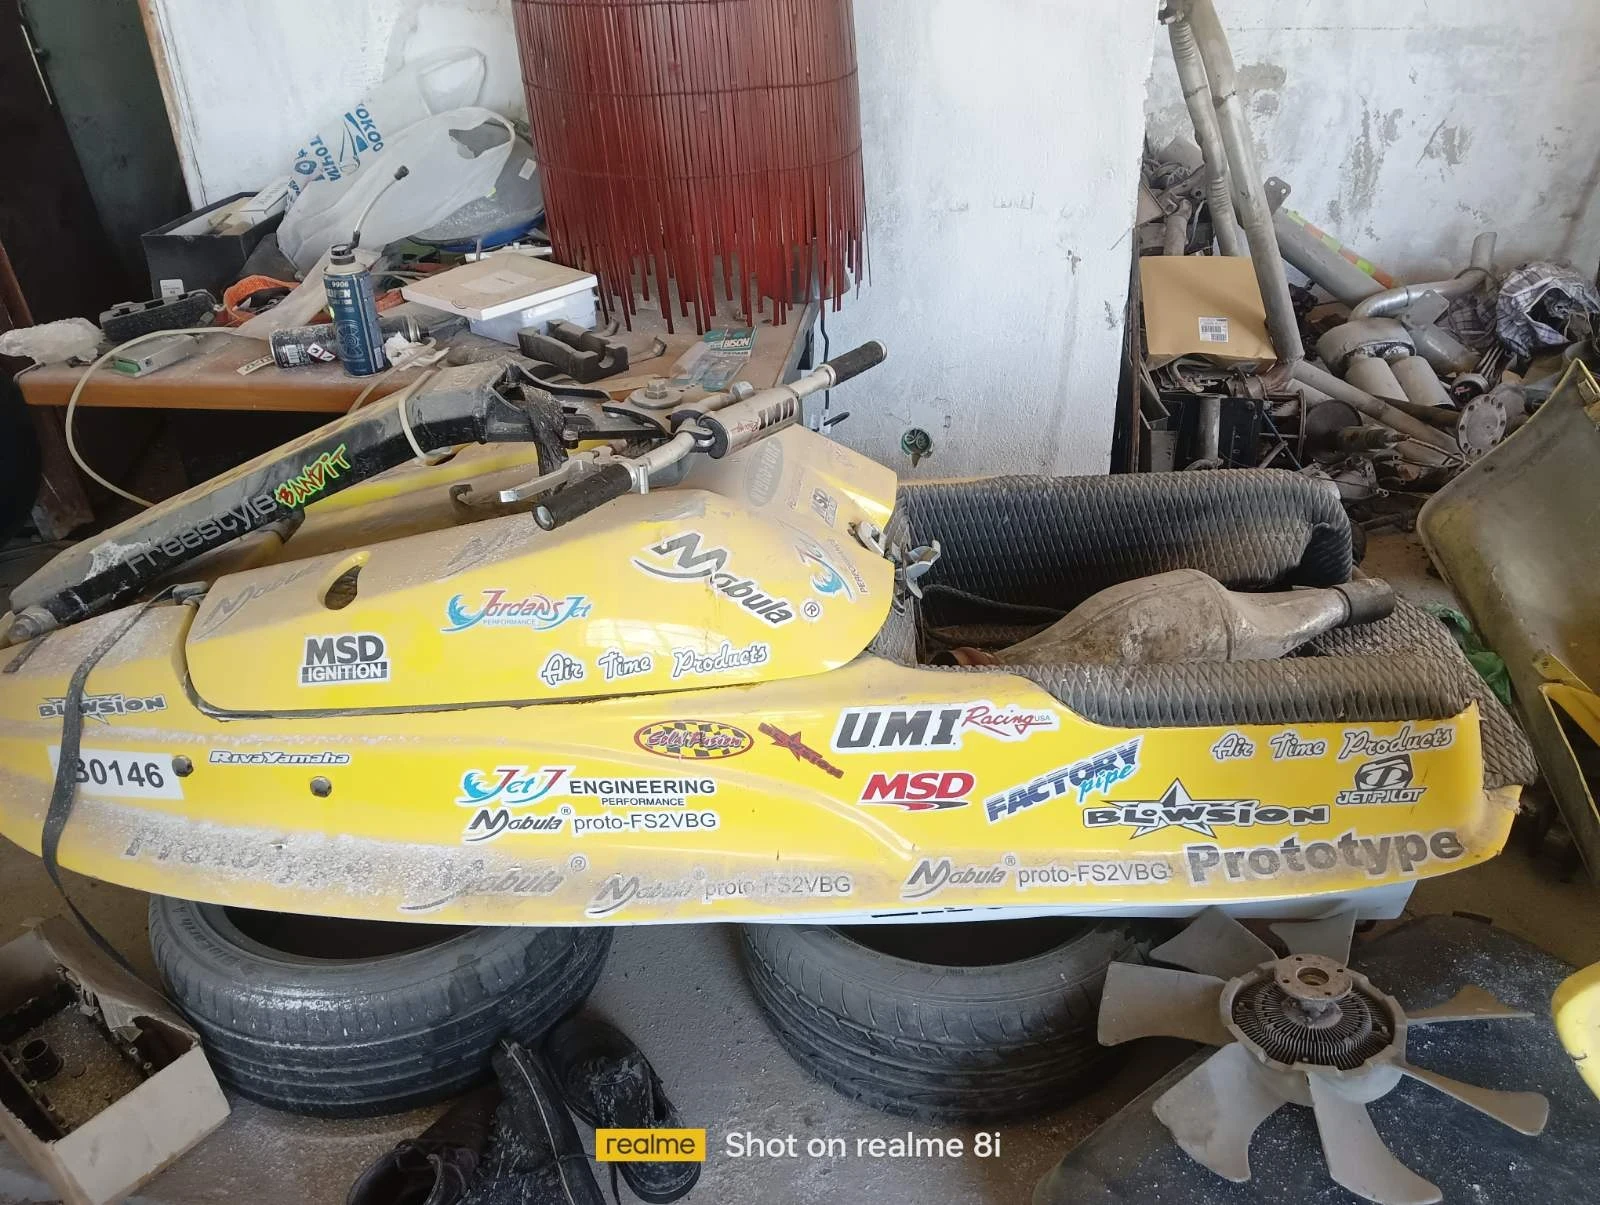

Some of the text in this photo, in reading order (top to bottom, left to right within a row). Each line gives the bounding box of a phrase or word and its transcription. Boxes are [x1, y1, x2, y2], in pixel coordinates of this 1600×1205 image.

[724, 337, 750, 348] BISON
[125, 494, 278, 576] Freestyle
[482, 618, 536, 626] PERFORMANCE
[305, 635, 384, 665] MSD
[307, 663, 383, 682] IGNITION
[541, 644, 767, 685] Air Time Products
[961, 705, 1040, 735] Racing
[1212, 726, 1452, 760] Air Time Products
[569, 780, 716, 795] ENGINEERING
[861, 772, 974, 800] MSD
[986, 738, 1140, 822] FACTORY
[1078, 764, 1134, 803] pipe
[601, 797, 685, 807] PERFORMANCE
[1336, 787, 1427, 805] JETPILOT
[574, 812, 717, 834] proto-FS2VBG
[1187, 830, 1465, 882] Prototype
[1018, 863, 1168, 887] proto-FS2VBG
